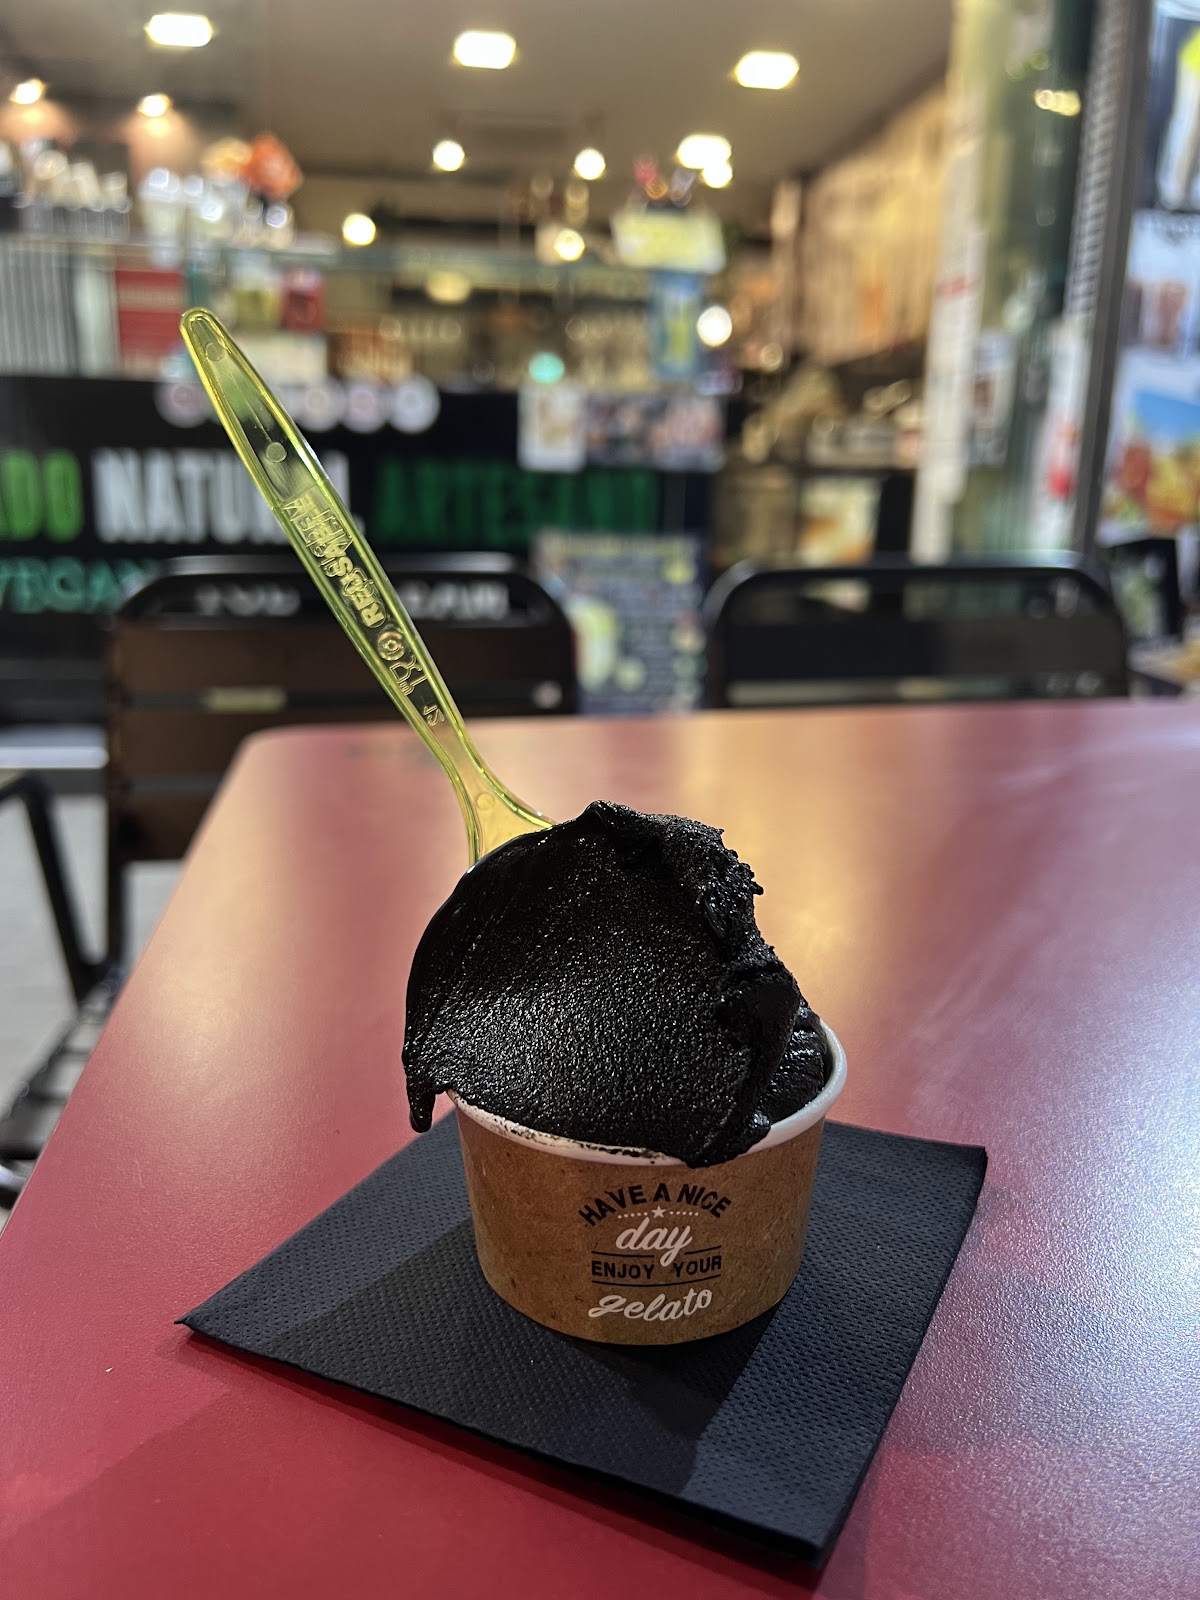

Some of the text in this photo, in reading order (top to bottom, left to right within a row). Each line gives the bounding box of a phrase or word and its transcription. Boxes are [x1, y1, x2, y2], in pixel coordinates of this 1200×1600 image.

[288, 493, 385, 627] REUSABLE
[578, 1182, 732, 1227] HAVE A NICE
[615, 1216, 693, 1267] day
[591, 1255, 722, 1279] ENJOY YOUR
[588, 1287, 713, 1322] gelato
